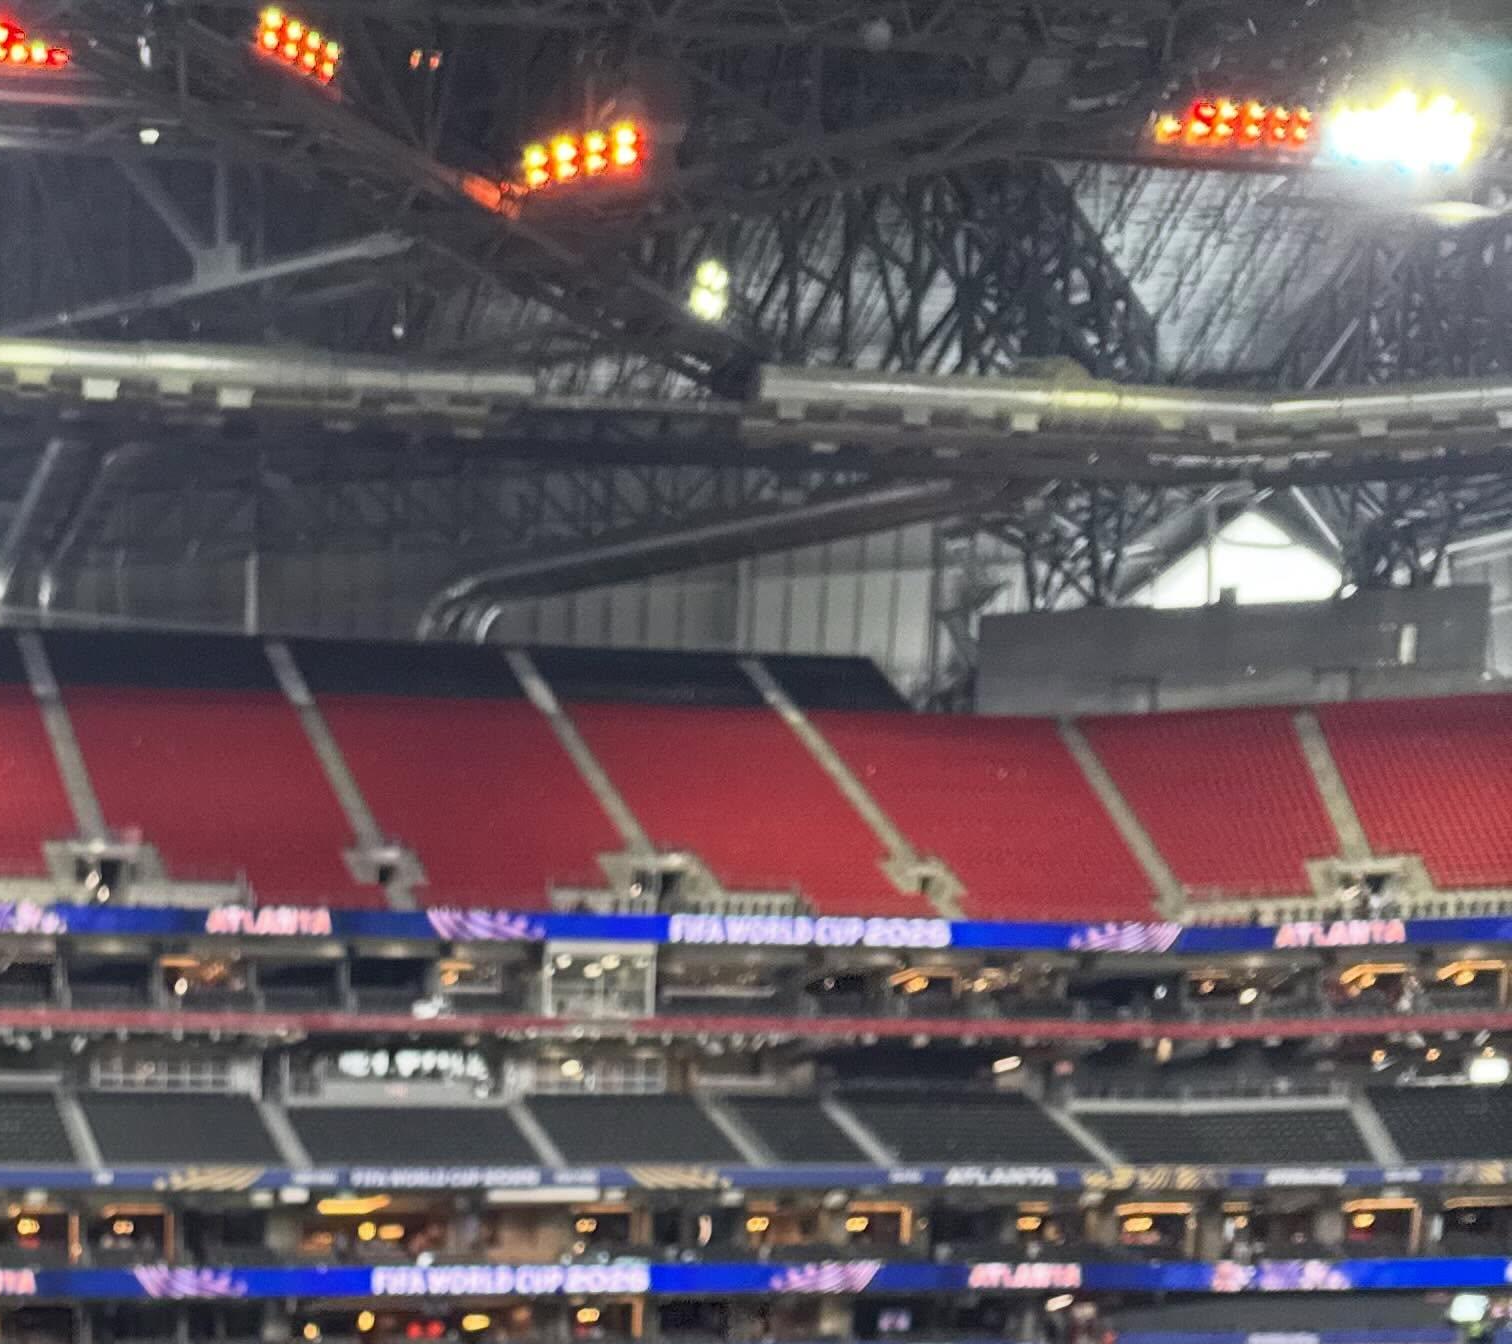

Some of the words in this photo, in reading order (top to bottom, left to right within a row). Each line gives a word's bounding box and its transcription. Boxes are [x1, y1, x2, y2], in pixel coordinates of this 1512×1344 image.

[204, 904, 332, 936] ATLANTA
[724, 915, 814, 946] WORLD
[813, 916, 865, 947] CUP
[862, 917, 952, 948] 2026
[1274, 919, 1407, 949] ATLANTA
[943, 1165, 1059, 1187] ATLANTA
[372, 1265, 428, 1295] FIFA
[425, 1265, 515, 1295] WORLD
[513, 1265, 566, 1294] CUP
[561, 1265, 650, 1294] 2026
[968, 1261, 1083, 1289] ATLANTA
